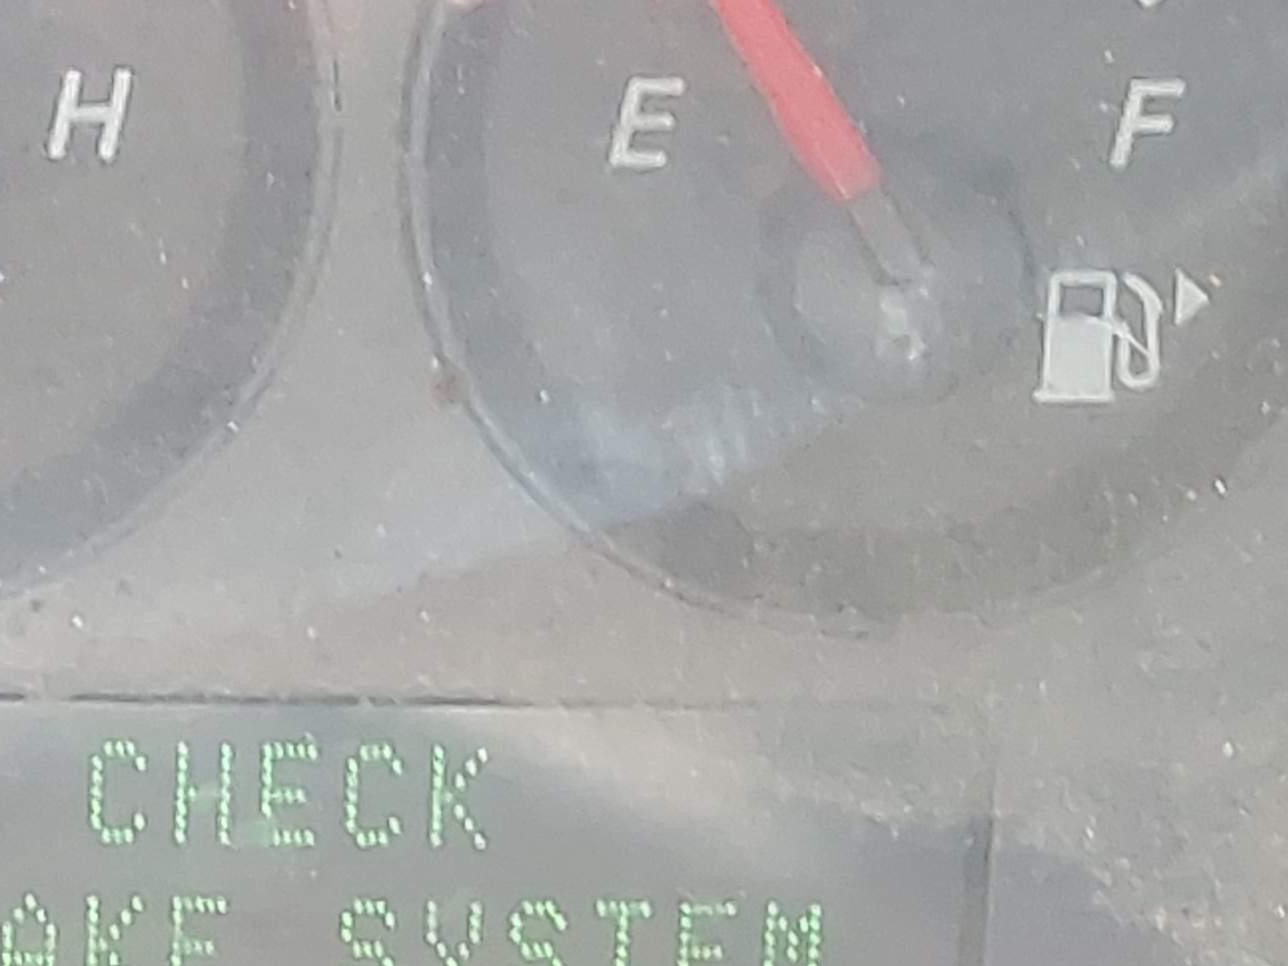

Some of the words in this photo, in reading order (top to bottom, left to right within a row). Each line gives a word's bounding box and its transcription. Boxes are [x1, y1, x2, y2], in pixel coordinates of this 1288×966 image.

[47, 68, 133, 161] H
[608, 76, 686, 169] E
[1110, 78, 1186, 169] F
[87, 739, 489, 847] CHECK
